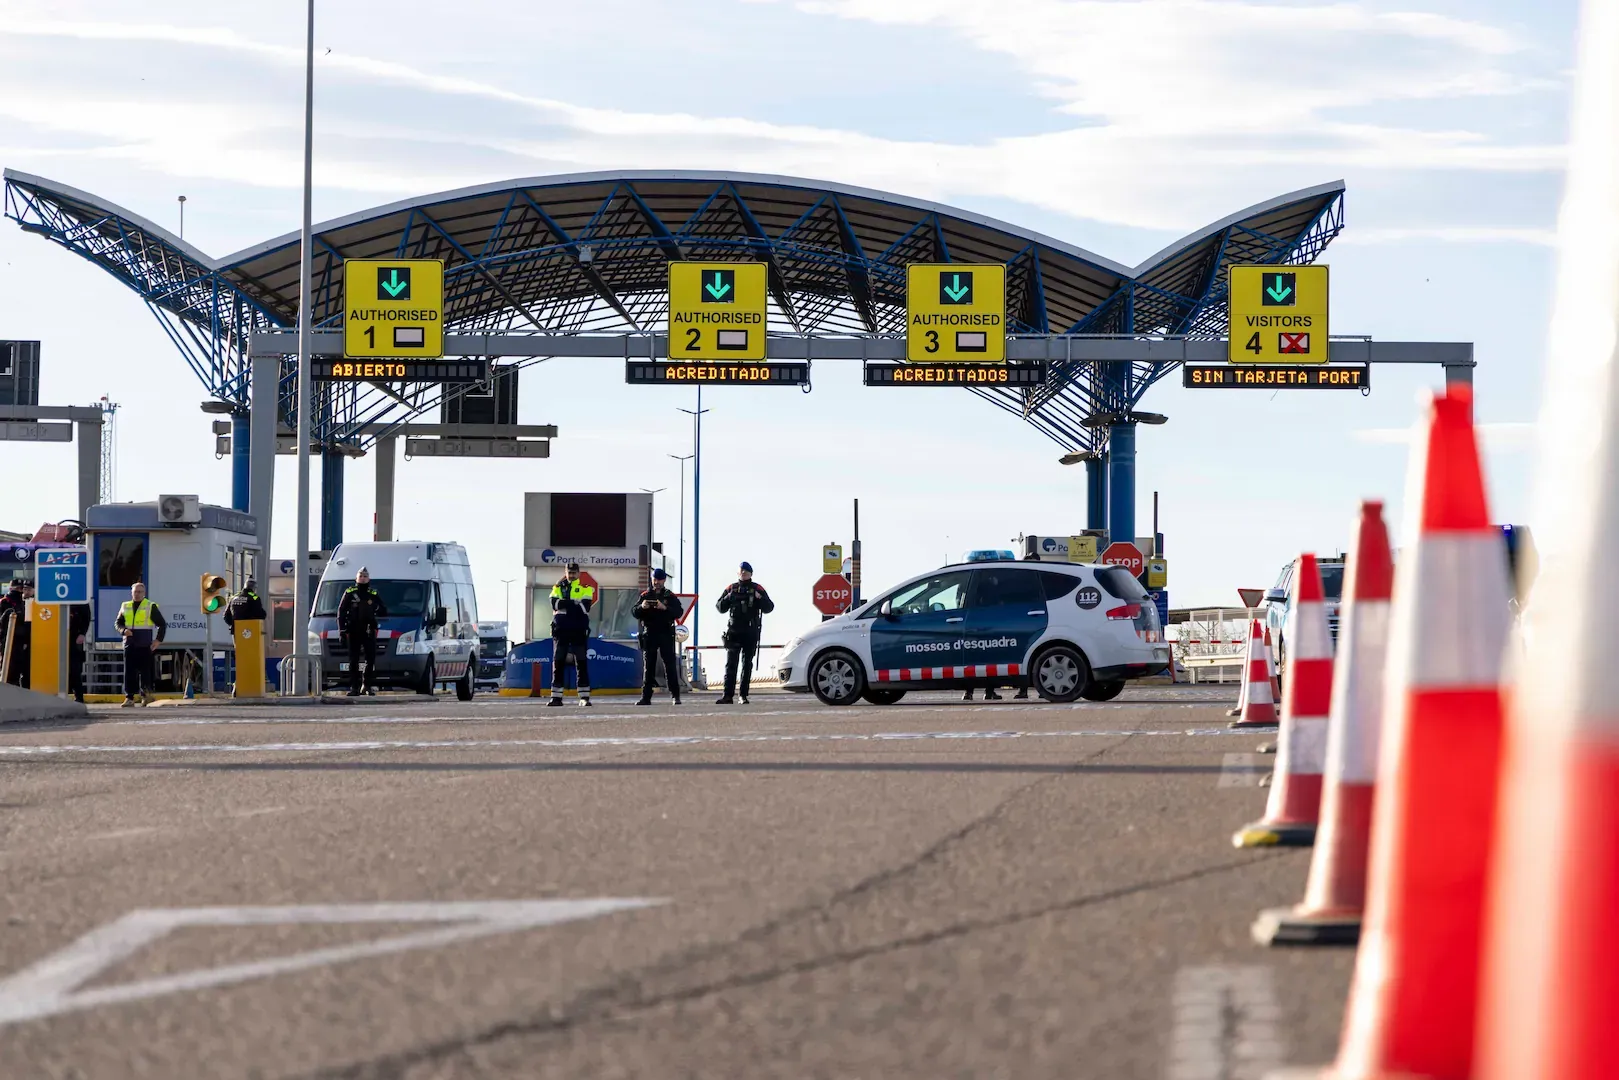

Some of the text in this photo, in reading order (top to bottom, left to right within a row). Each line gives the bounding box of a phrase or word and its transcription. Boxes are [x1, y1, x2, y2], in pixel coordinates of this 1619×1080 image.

[350, 310, 438, 321] AUTHORISED
[674, 312, 762, 324] AUTHORISED
[912, 314, 1000, 325] AUTHORISED
[1246, 315, 1312, 327] VISITORS
[363, 325, 375, 349] 1
[685, 328, 701, 351] 2
[924, 330, 940, 353] 3
[1245, 332, 1262, 354] 4
[332, 363, 406, 377] ABIERTO
[666, 366, 770, 380] ACREDITADO
[893, 368, 1008, 381] ACREDITADOS
[1192, 370, 1361, 384] SIN TARJETA PORT
[46, 552, 80, 564] A-27
[557, 554, 636, 565] Port de Tarragona
[54, 571, 71, 581] km
[56, 582, 69, 599] 0
[816, 589, 849, 600] STOP
[1079, 592, 1098, 602] 112
[173, 613, 186, 621] EIX
[905, 635, 1018, 653] mossos d'esquadra
[597, 654, 635, 664] Port Tarragona
